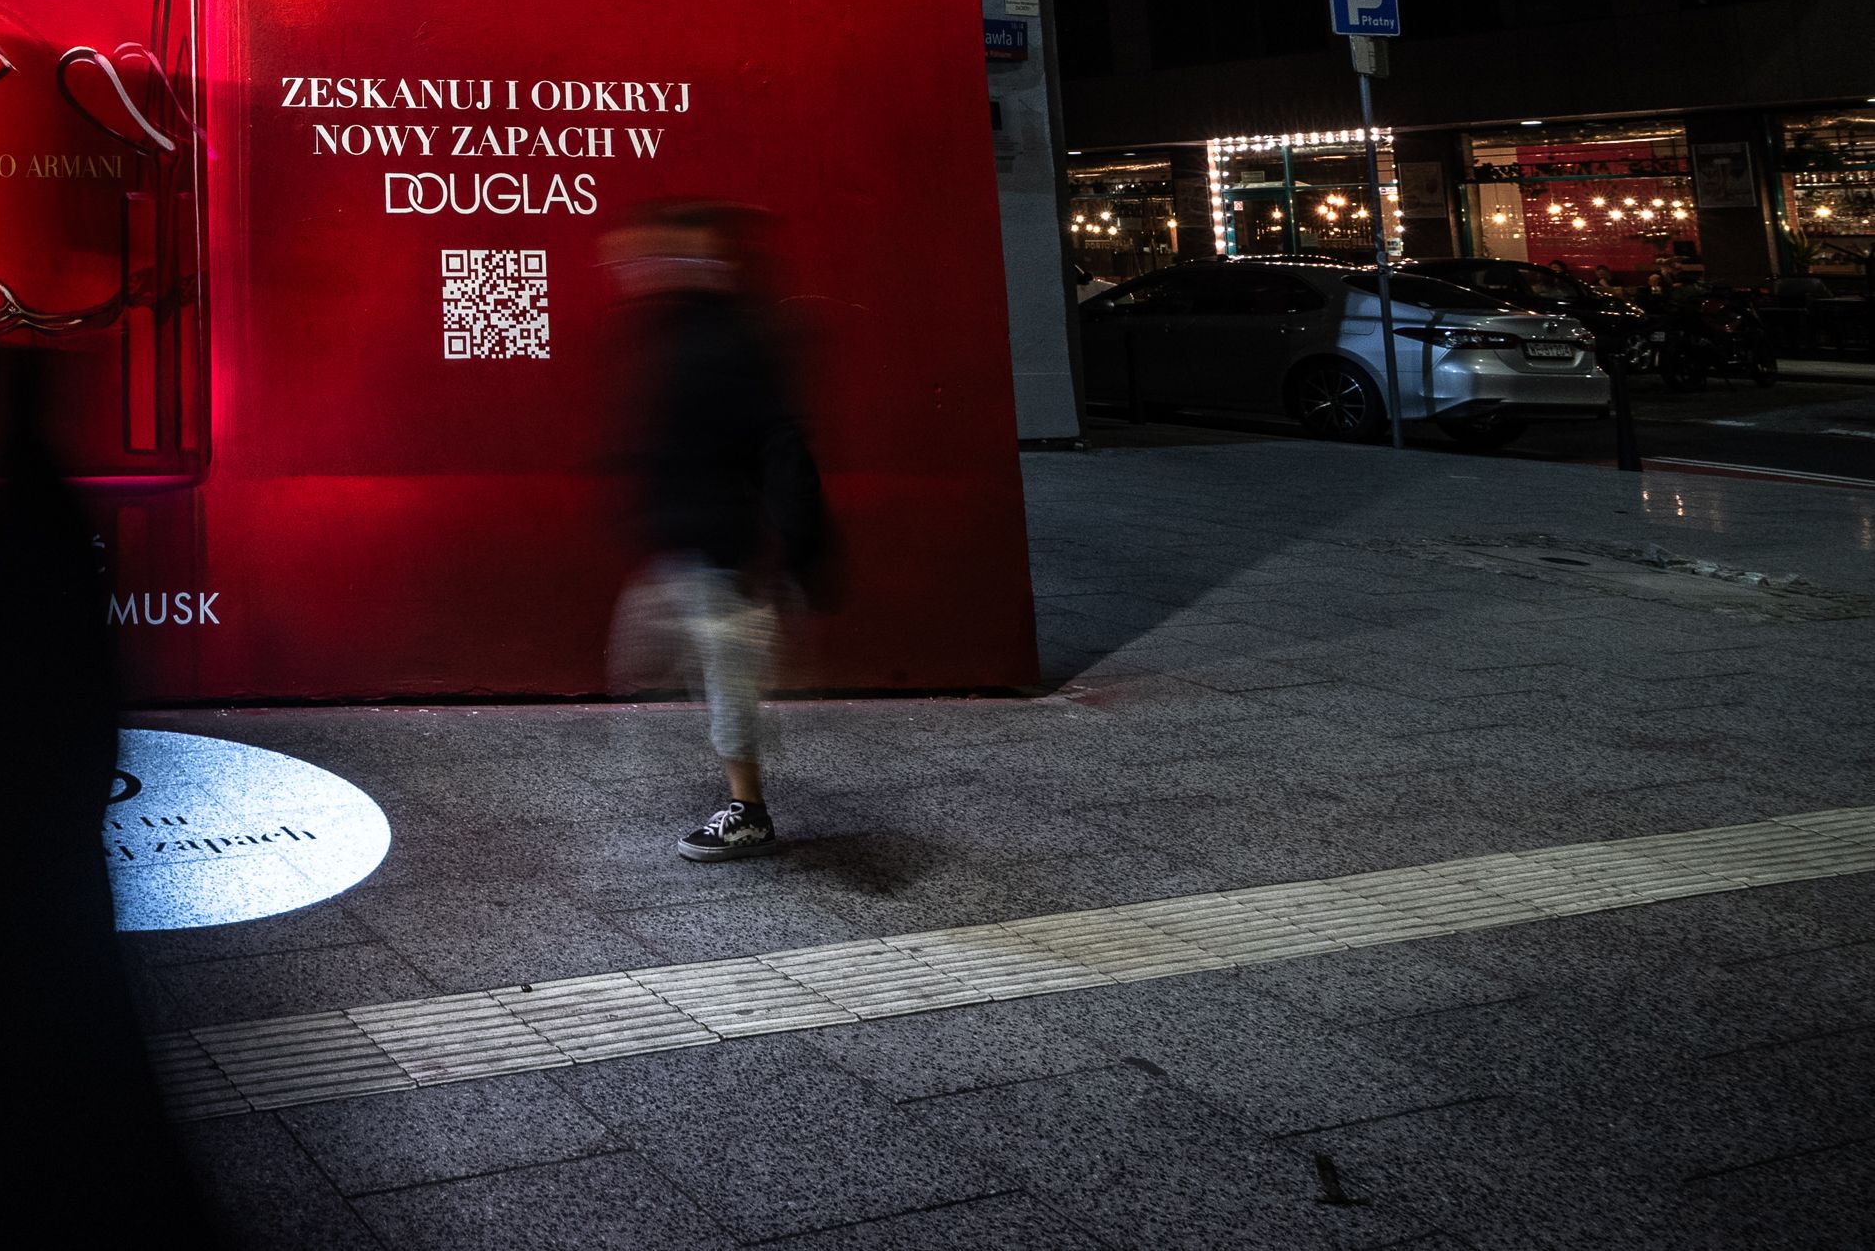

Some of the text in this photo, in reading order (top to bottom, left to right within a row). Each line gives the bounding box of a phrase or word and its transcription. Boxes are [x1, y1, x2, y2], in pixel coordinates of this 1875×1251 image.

[984, 27, 1012, 46] awła
[1361, 15, 1395, 29] Płatny
[280, 77, 692, 113] ZESKANUJ I ODKRYJ
[313, 124, 665, 159] NOWY ZAPACH W
[26, 154, 124, 179] ARMANI
[384, 172, 598, 215] DOUGLAS
[105, 592, 220, 627] MUSK
